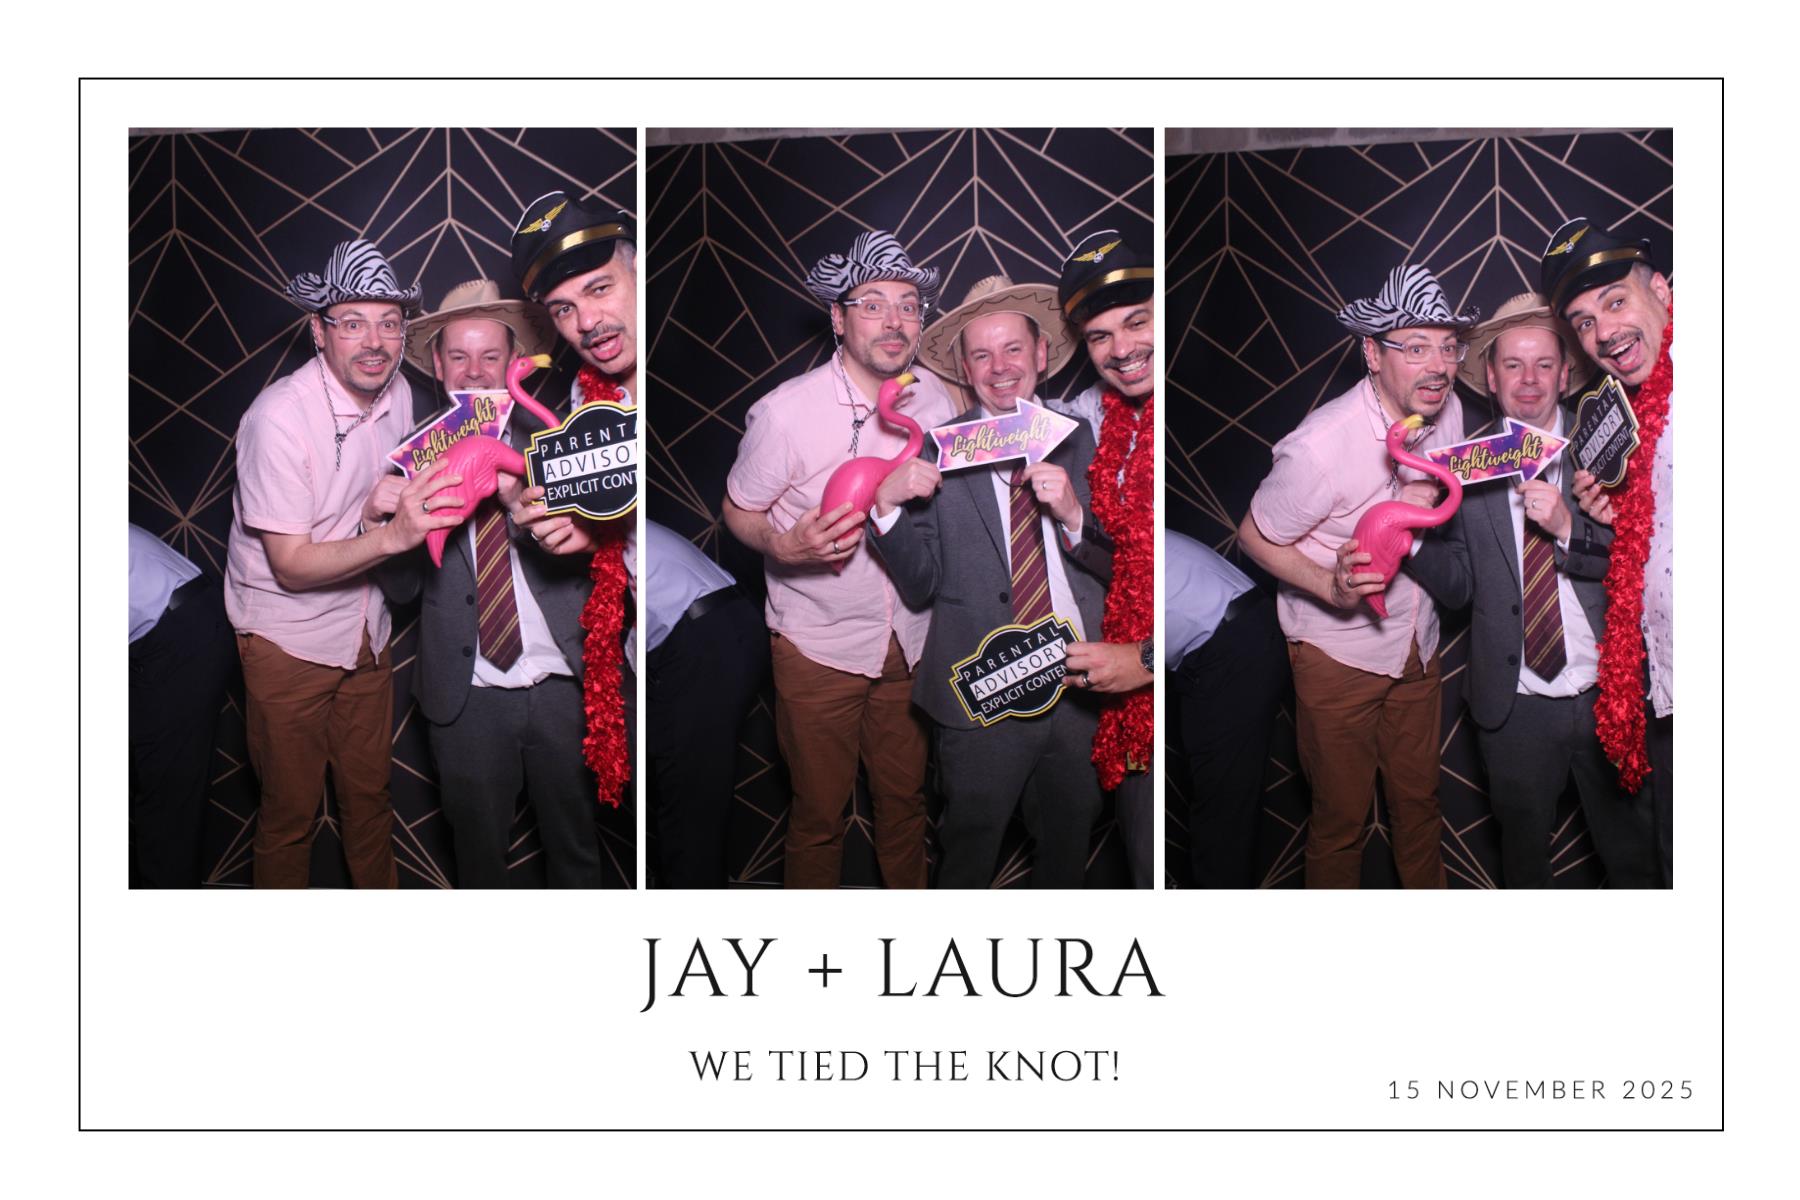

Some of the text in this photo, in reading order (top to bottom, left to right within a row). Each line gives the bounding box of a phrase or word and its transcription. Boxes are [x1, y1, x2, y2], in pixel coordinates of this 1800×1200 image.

[412, 397, 496, 471] Lightweight
[541, 420, 637, 457] PARENT
[951, 414, 1049, 462] Lightweight
[1574, 393, 1615, 452] PARENTAL
[1580, 406, 1623, 466] ADVISORY
[1604, 426, 1630, 461] CONTENT
[545, 442, 637, 480] ADVISO
[1449, 432, 1543, 480] Lightweight
[547, 470, 637, 500] EXPLICIT CONT
[964, 626, 1060, 681] PARENTAL
[973, 640, 1066, 699] ADVISORY
[980, 664, 1068, 714] EXPLICIT CONTEN
